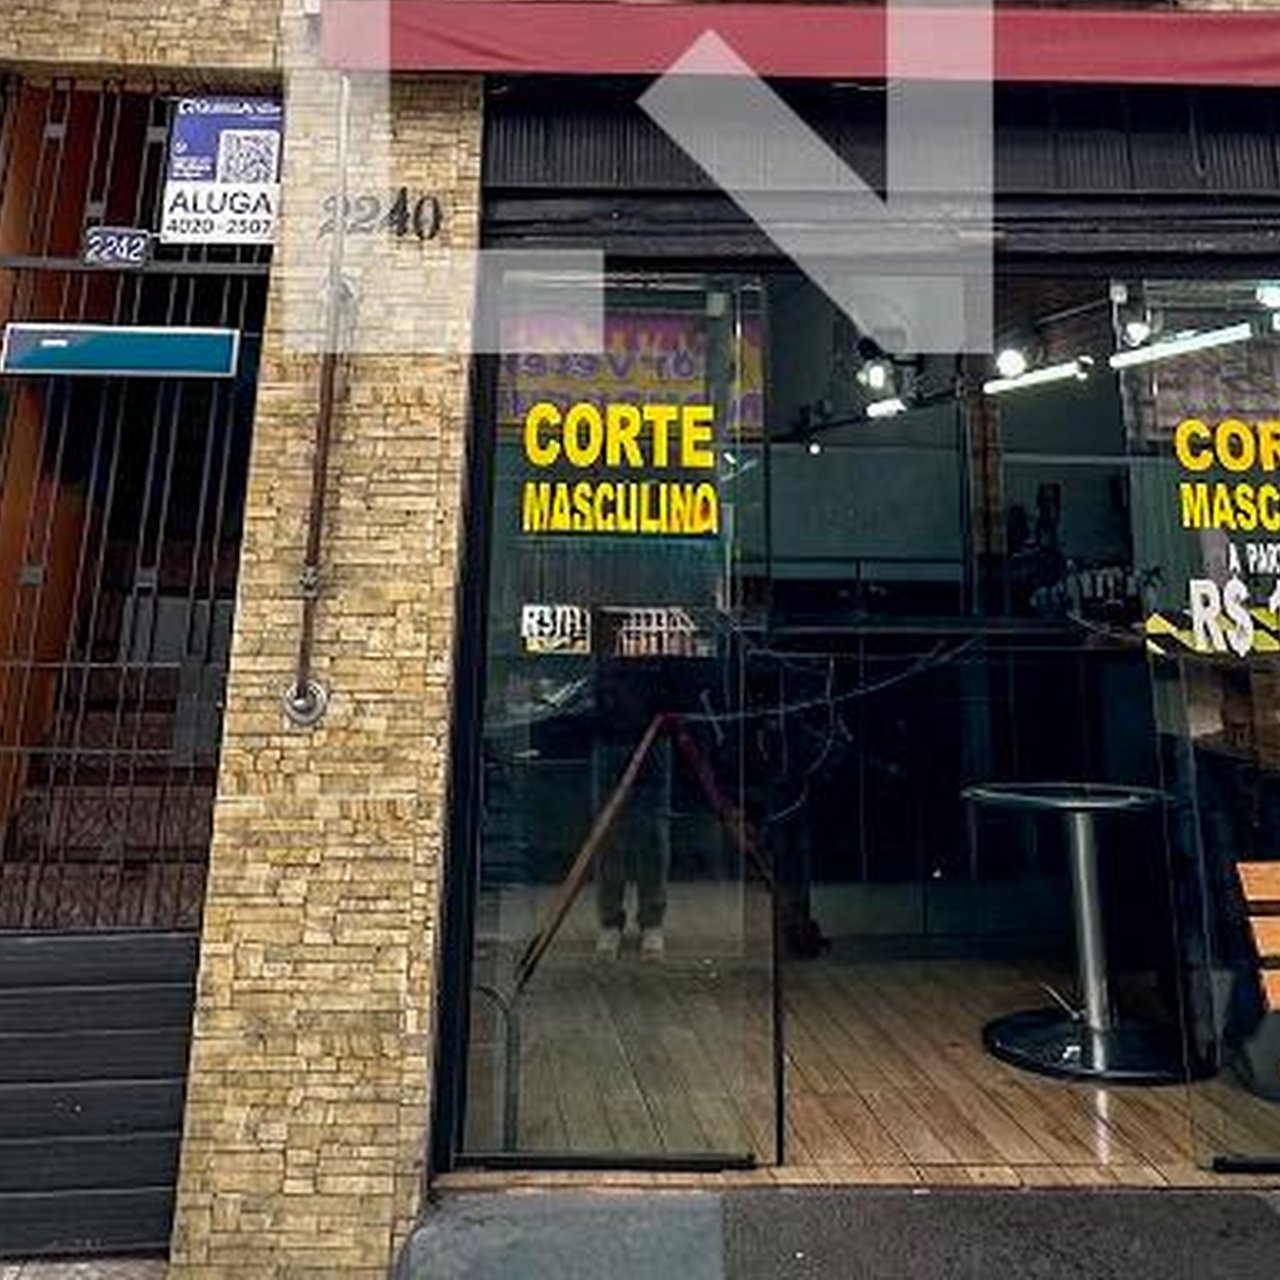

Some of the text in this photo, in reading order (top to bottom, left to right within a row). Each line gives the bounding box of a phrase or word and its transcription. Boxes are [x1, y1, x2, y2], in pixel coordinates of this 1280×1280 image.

[169, 190, 272, 214] ALUGA
[525, 403, 715, 469] CORTE
[523, 482, 719, 535] MASCULINO
[1228, 543, 1242, 573] A
[1189, 574, 1255, 658] R$
